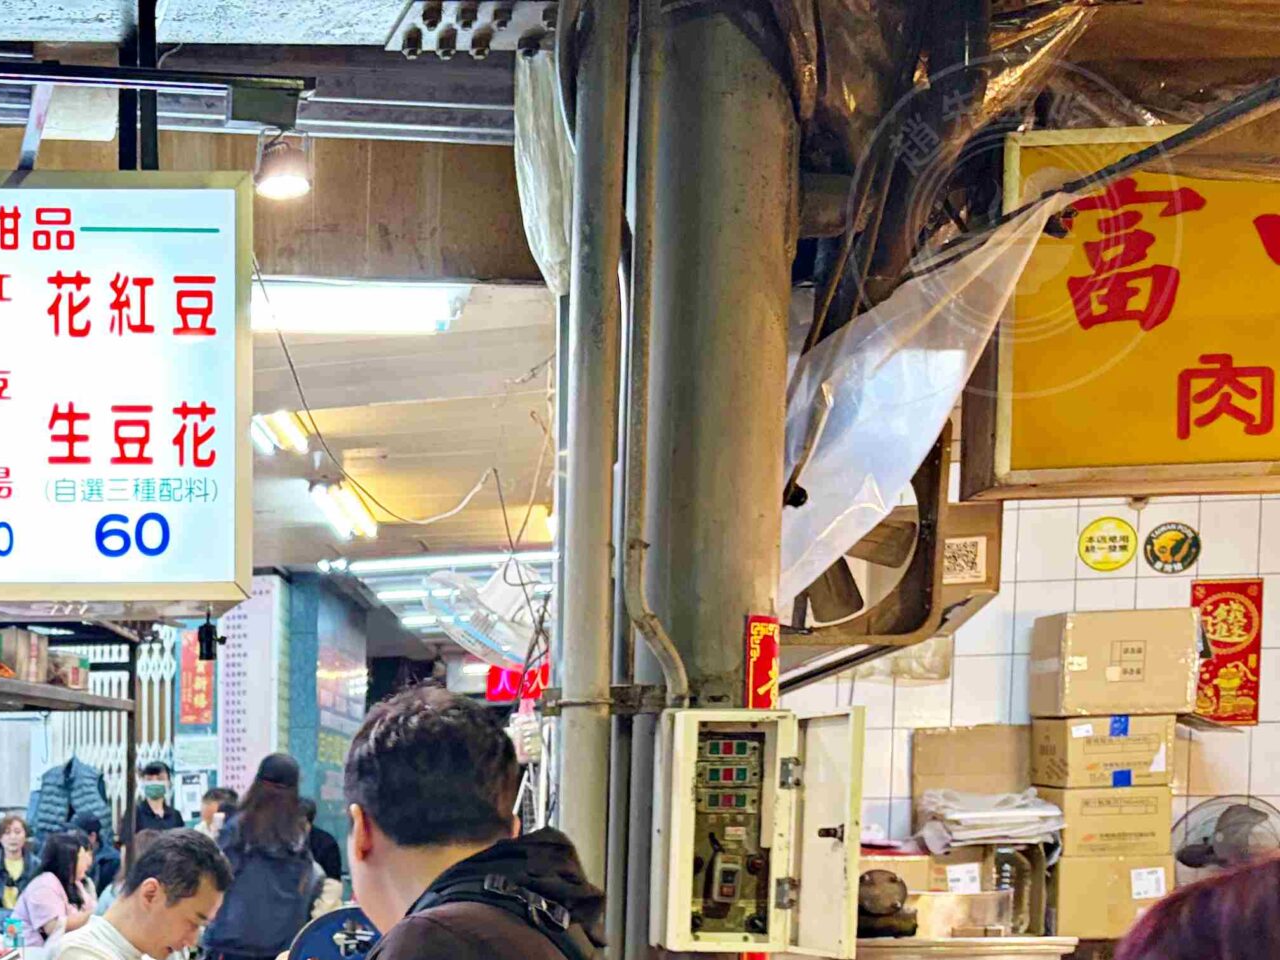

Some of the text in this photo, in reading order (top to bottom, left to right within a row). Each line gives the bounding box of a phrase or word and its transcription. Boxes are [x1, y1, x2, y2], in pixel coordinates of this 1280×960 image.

[1177, 353, 1275, 440] 肉
[45, 476, 218, 504] (自選三種配料)
[95, 512, 171, 558] 60
